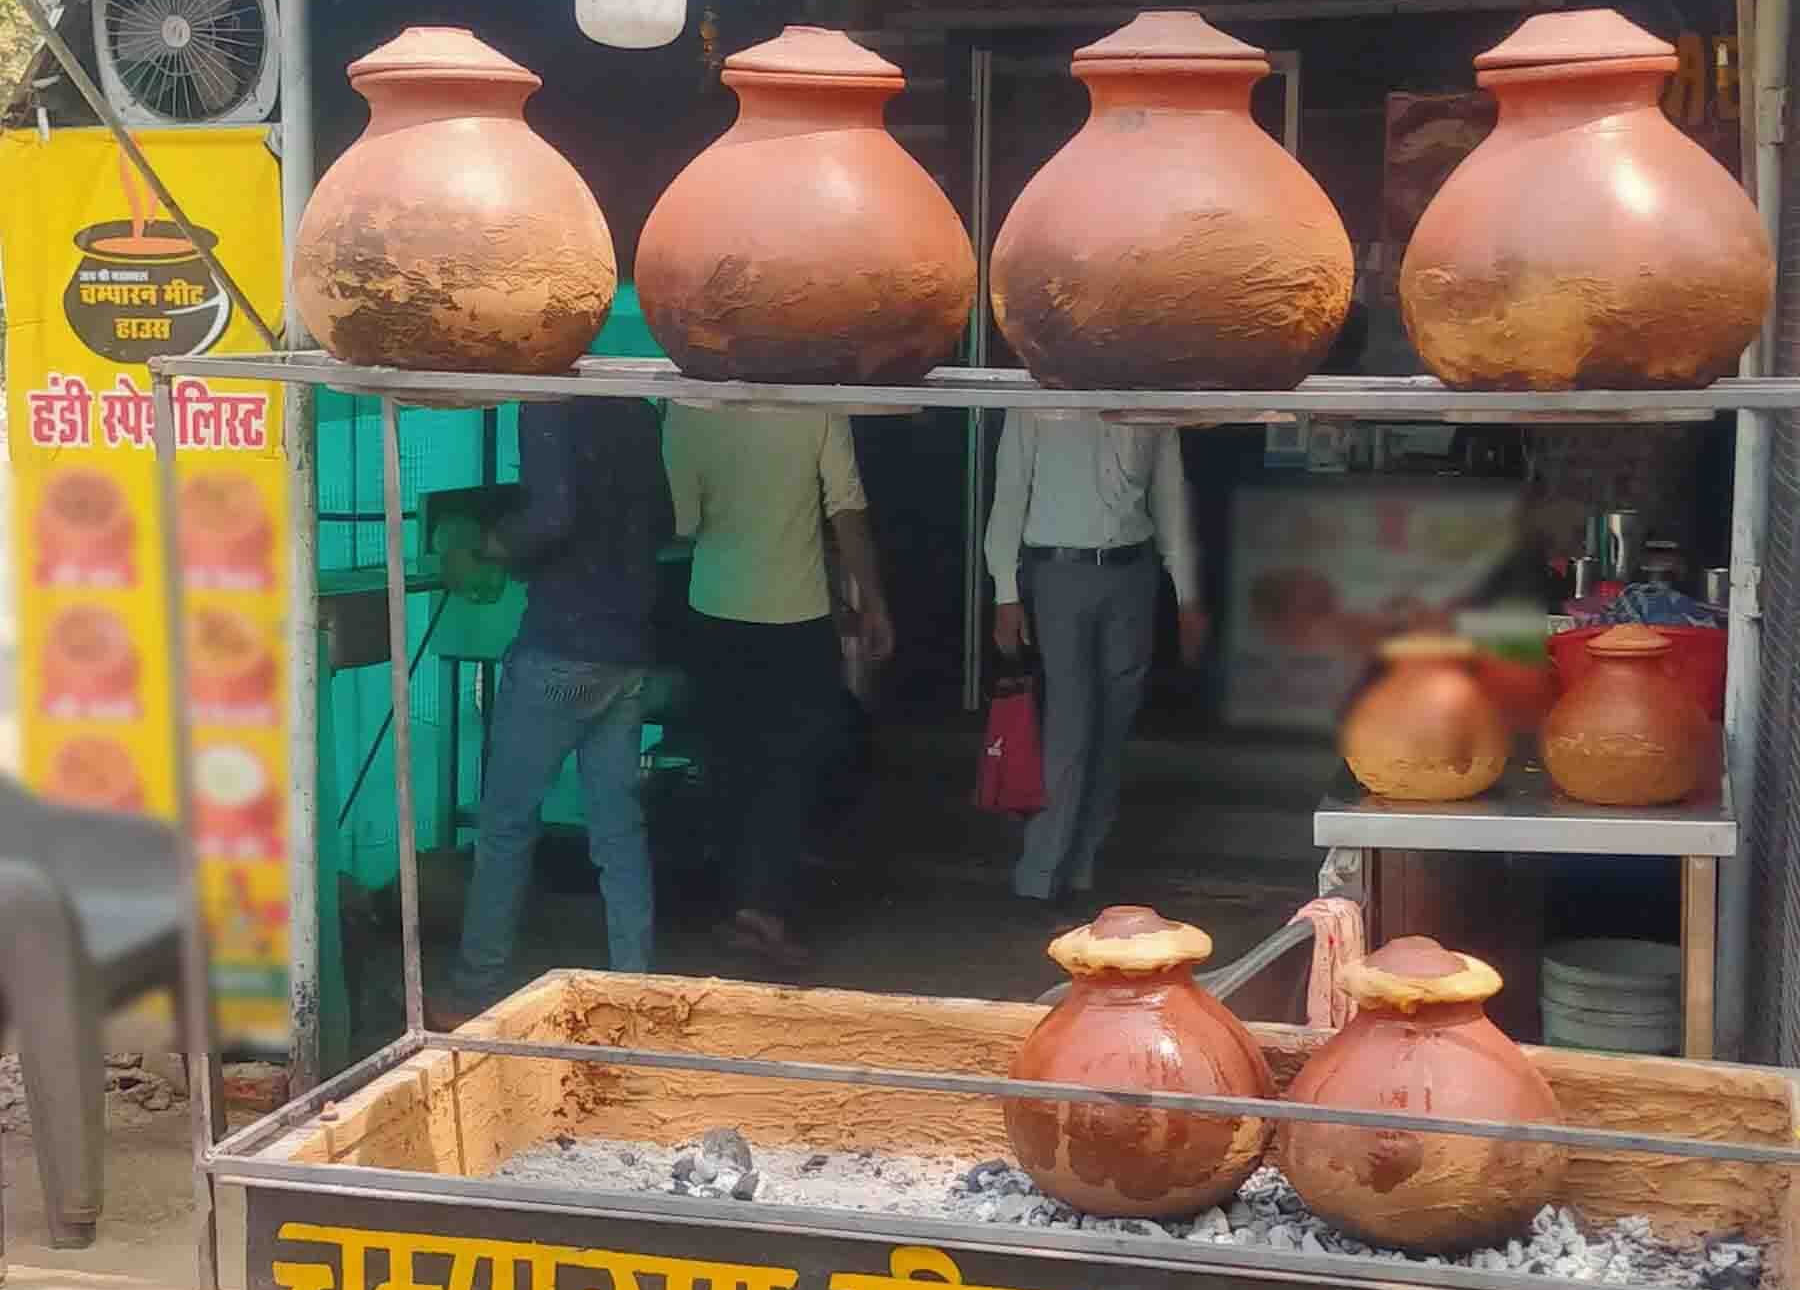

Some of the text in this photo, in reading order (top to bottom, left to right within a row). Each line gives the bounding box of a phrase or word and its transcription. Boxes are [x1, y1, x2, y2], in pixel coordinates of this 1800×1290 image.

[162, 277, 205, 306] मीट
[113, 317, 172, 340] हाउस
[29, 375, 92, 446] हंडी
